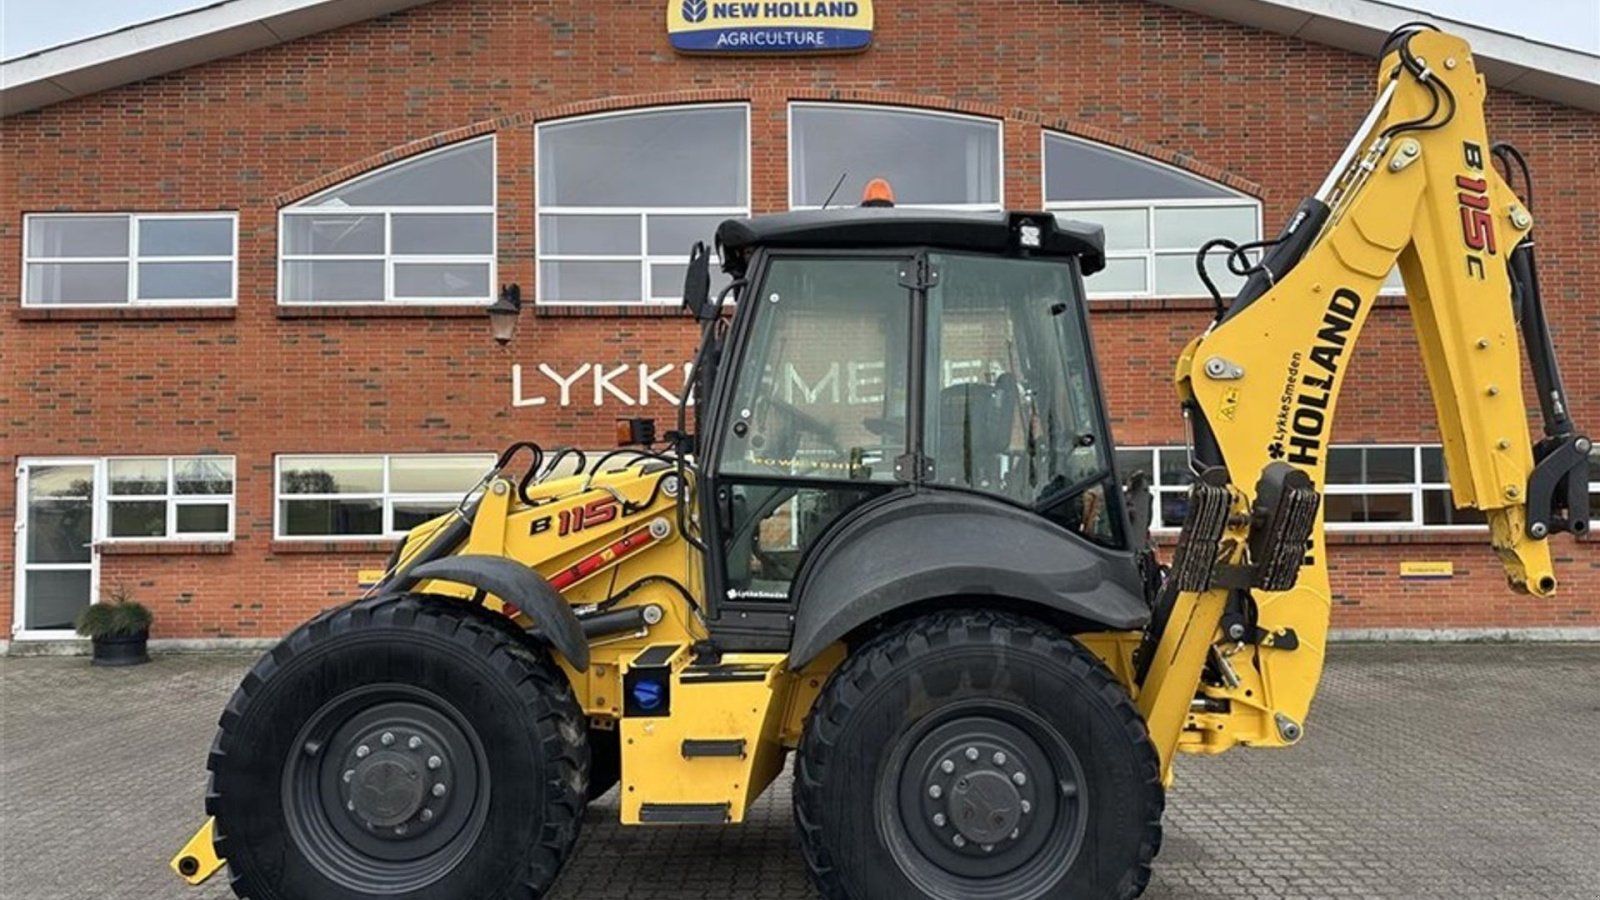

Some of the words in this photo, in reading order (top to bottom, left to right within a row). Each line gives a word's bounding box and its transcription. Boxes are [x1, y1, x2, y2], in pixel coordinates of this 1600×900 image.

[713, 2, 758, 18] NEW
[764, 1, 858, 18] HOLLAND
[717, 31, 824, 46] AGRICULTURE
[1274, 351, 1302, 441] LykkeSmeden
[1287, 287, 1362, 466] HOLLAND
